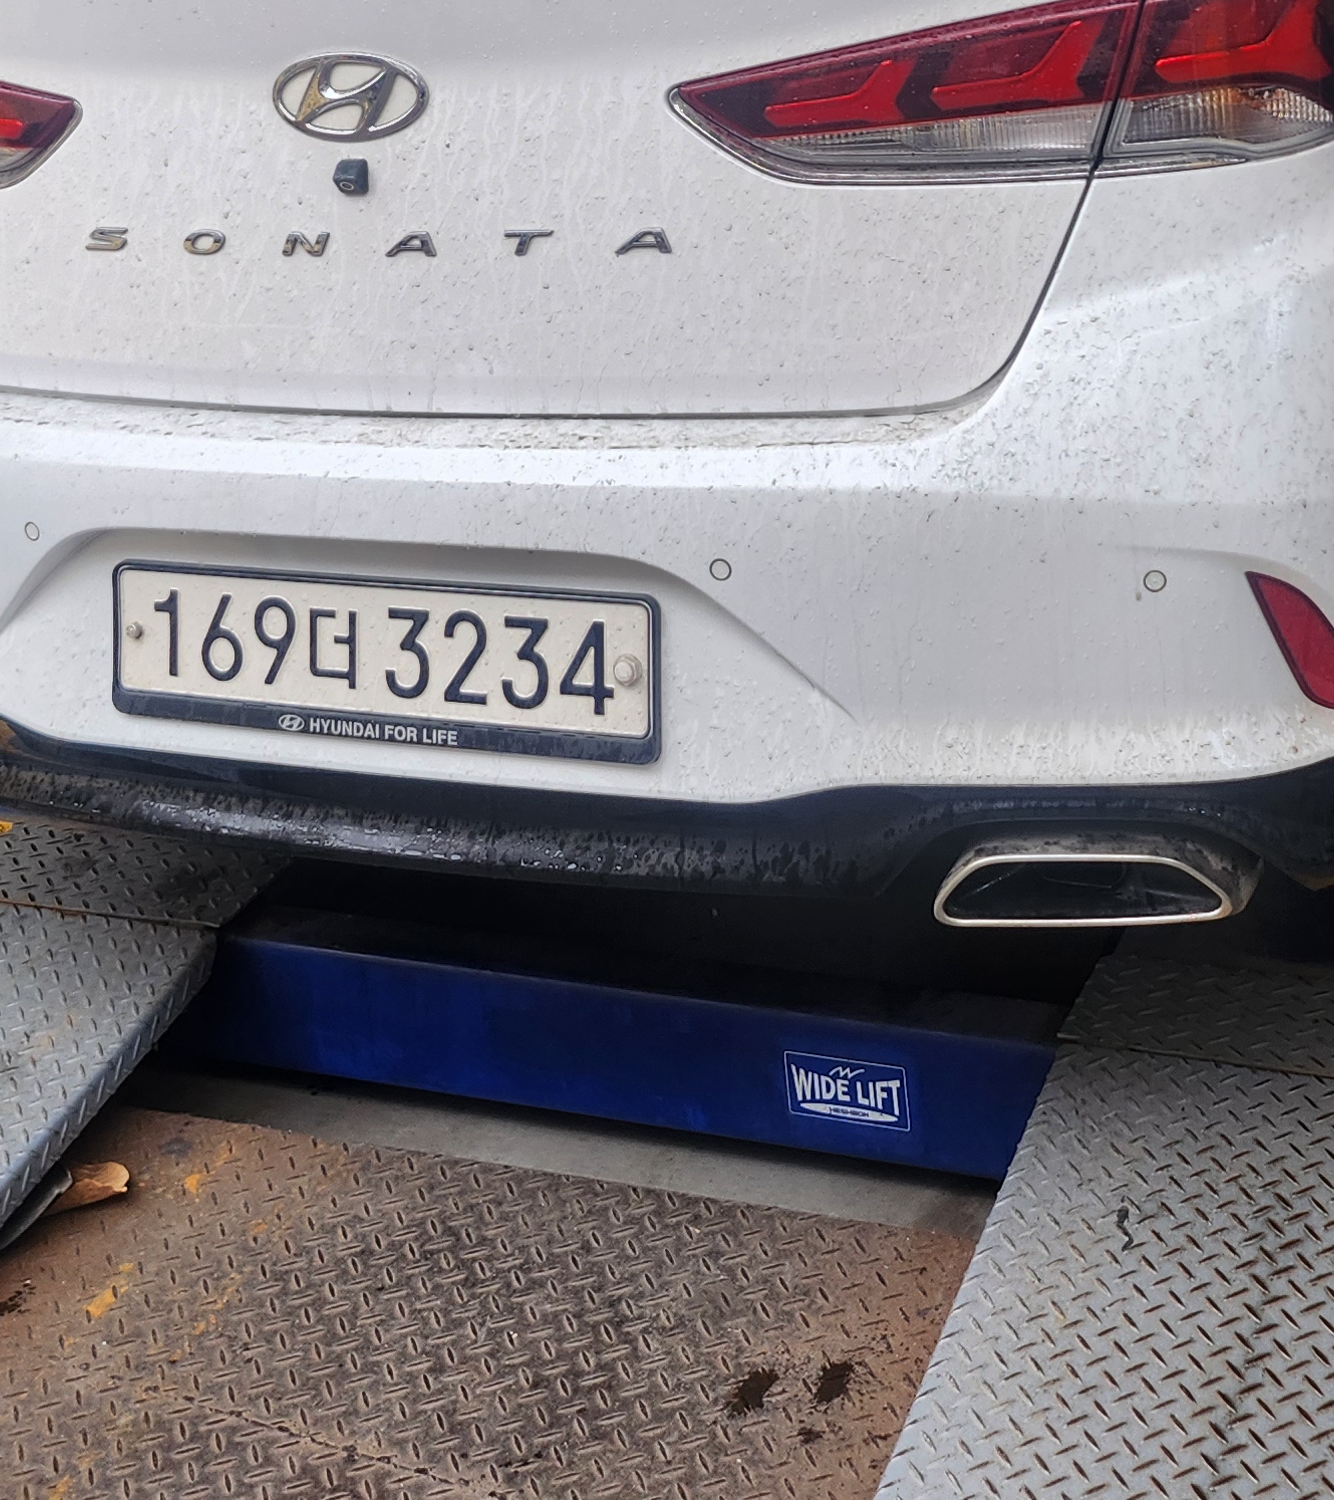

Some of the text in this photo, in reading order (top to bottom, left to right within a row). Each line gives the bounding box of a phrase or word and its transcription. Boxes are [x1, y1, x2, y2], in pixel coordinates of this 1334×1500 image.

[85, 226, 673, 257] SONATA
[309, 717, 458, 746] HYUNDAI FOR LIFE
[790, 1063, 901, 1116] WIDE LIFT
